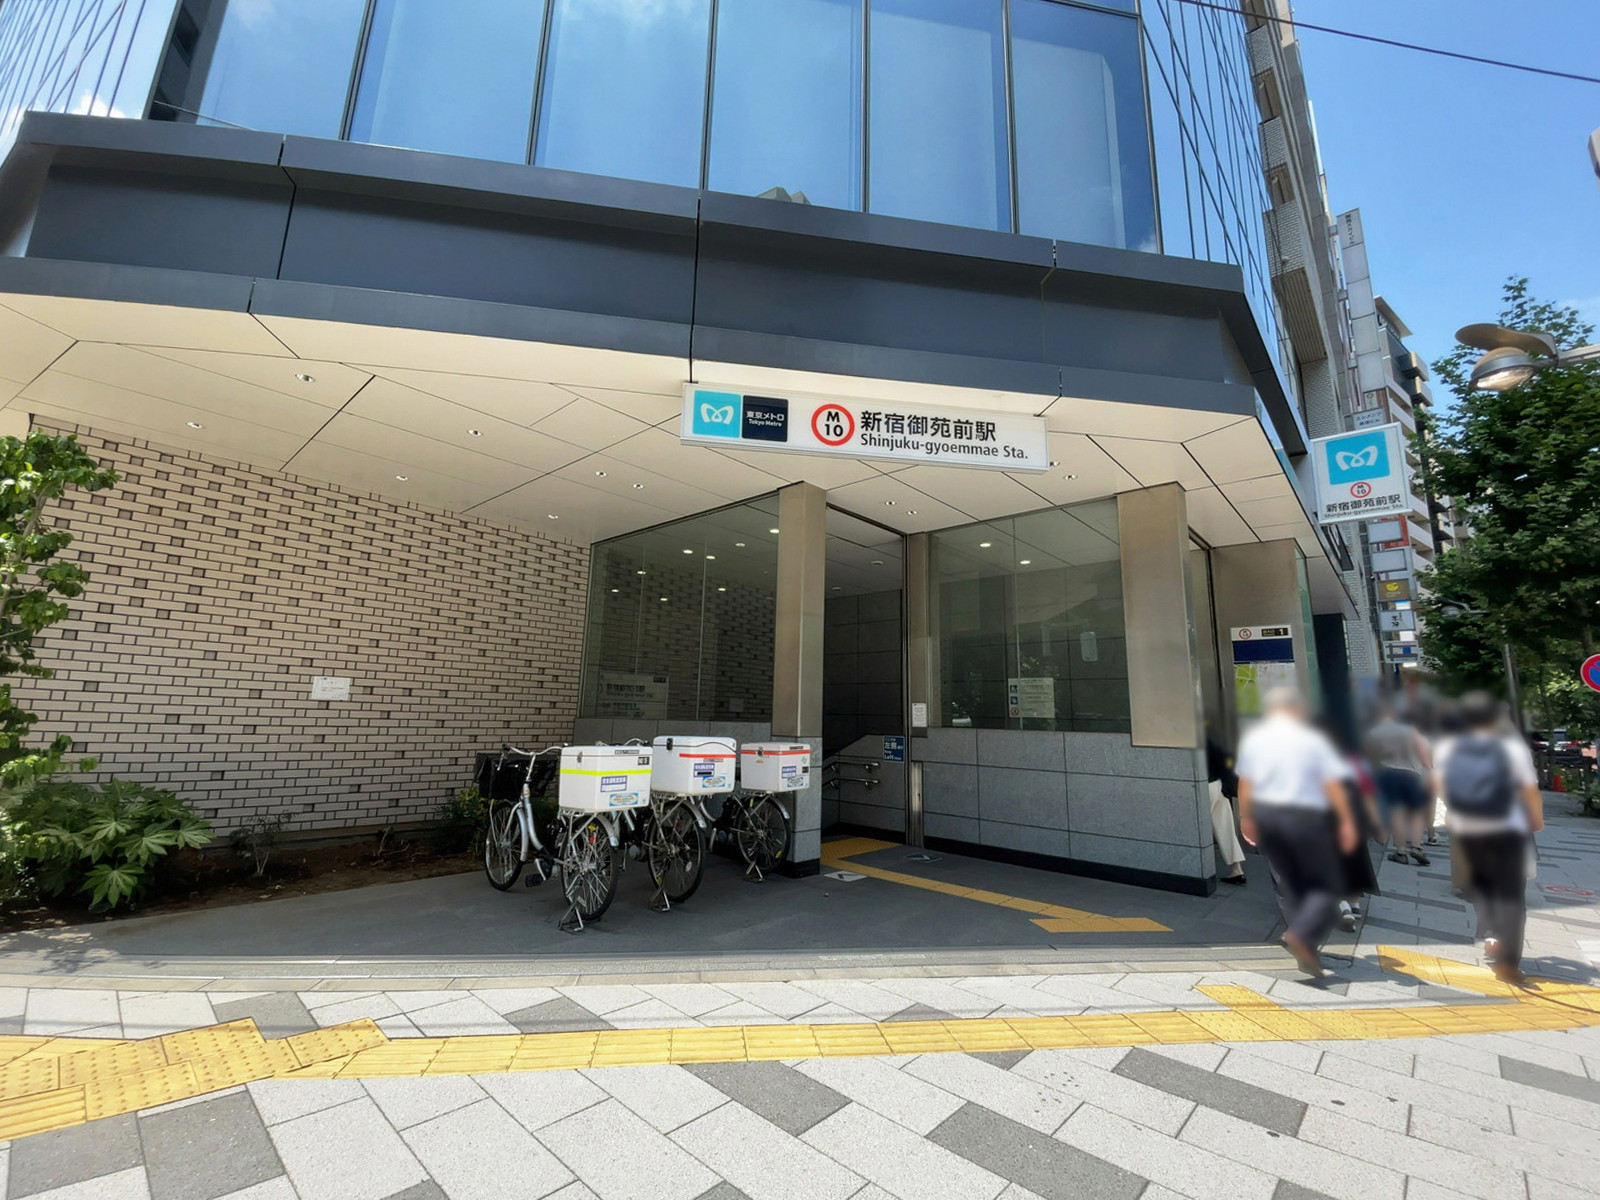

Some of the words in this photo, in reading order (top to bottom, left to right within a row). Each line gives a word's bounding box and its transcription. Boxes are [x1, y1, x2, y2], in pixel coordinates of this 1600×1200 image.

[746, 411, 785, 422] 東京メトロ
[748, 419, 765, 427] Tokyo
[826, 410, 840, 423] M
[824, 423, 844, 437] 10
[860, 410, 996, 442] 新宿御苑前駅
[860, 433, 999, 456] Shinjuku-gyoemmae
[1003, 445, 1028, 459] Sta.
[1326, 494, 1401, 513] 新宿御苑前駅
